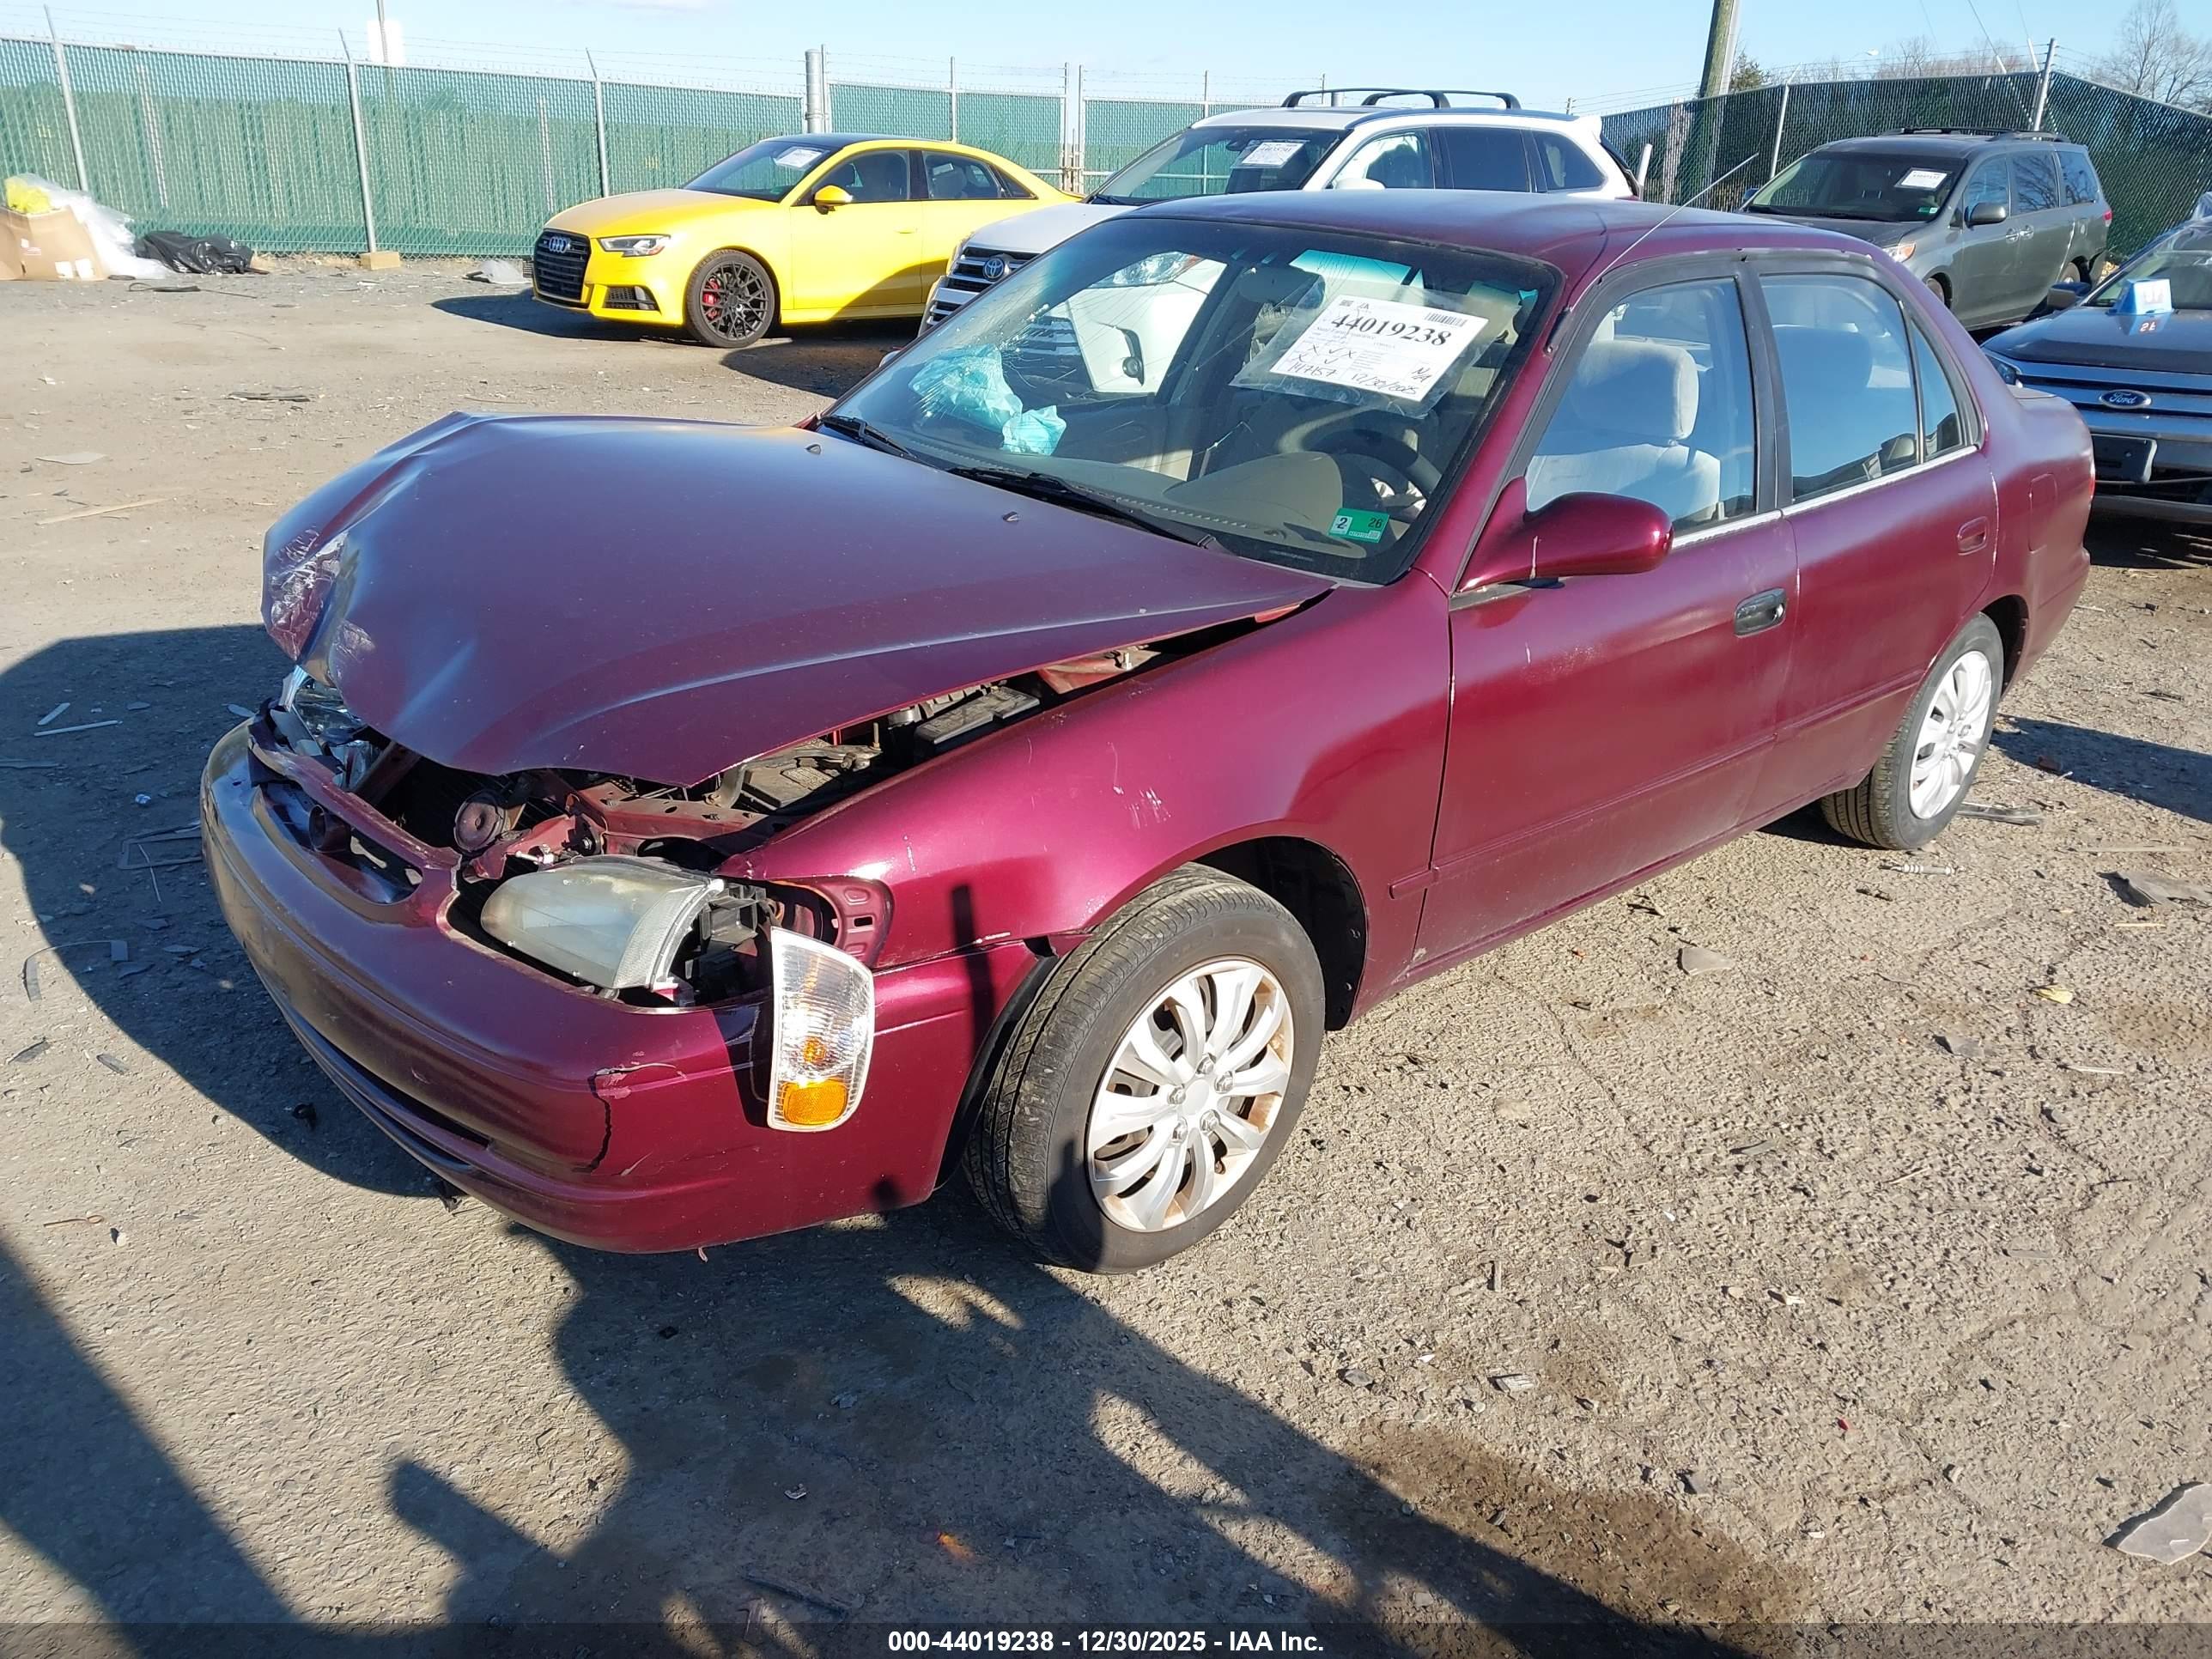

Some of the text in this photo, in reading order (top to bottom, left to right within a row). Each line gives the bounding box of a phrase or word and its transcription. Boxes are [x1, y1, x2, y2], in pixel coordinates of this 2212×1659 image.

[1331, 314, 1452, 346] 44019238
[2109, 392, 2137, 404] Ford
[1336, 517, 1384, 530] 2 26
